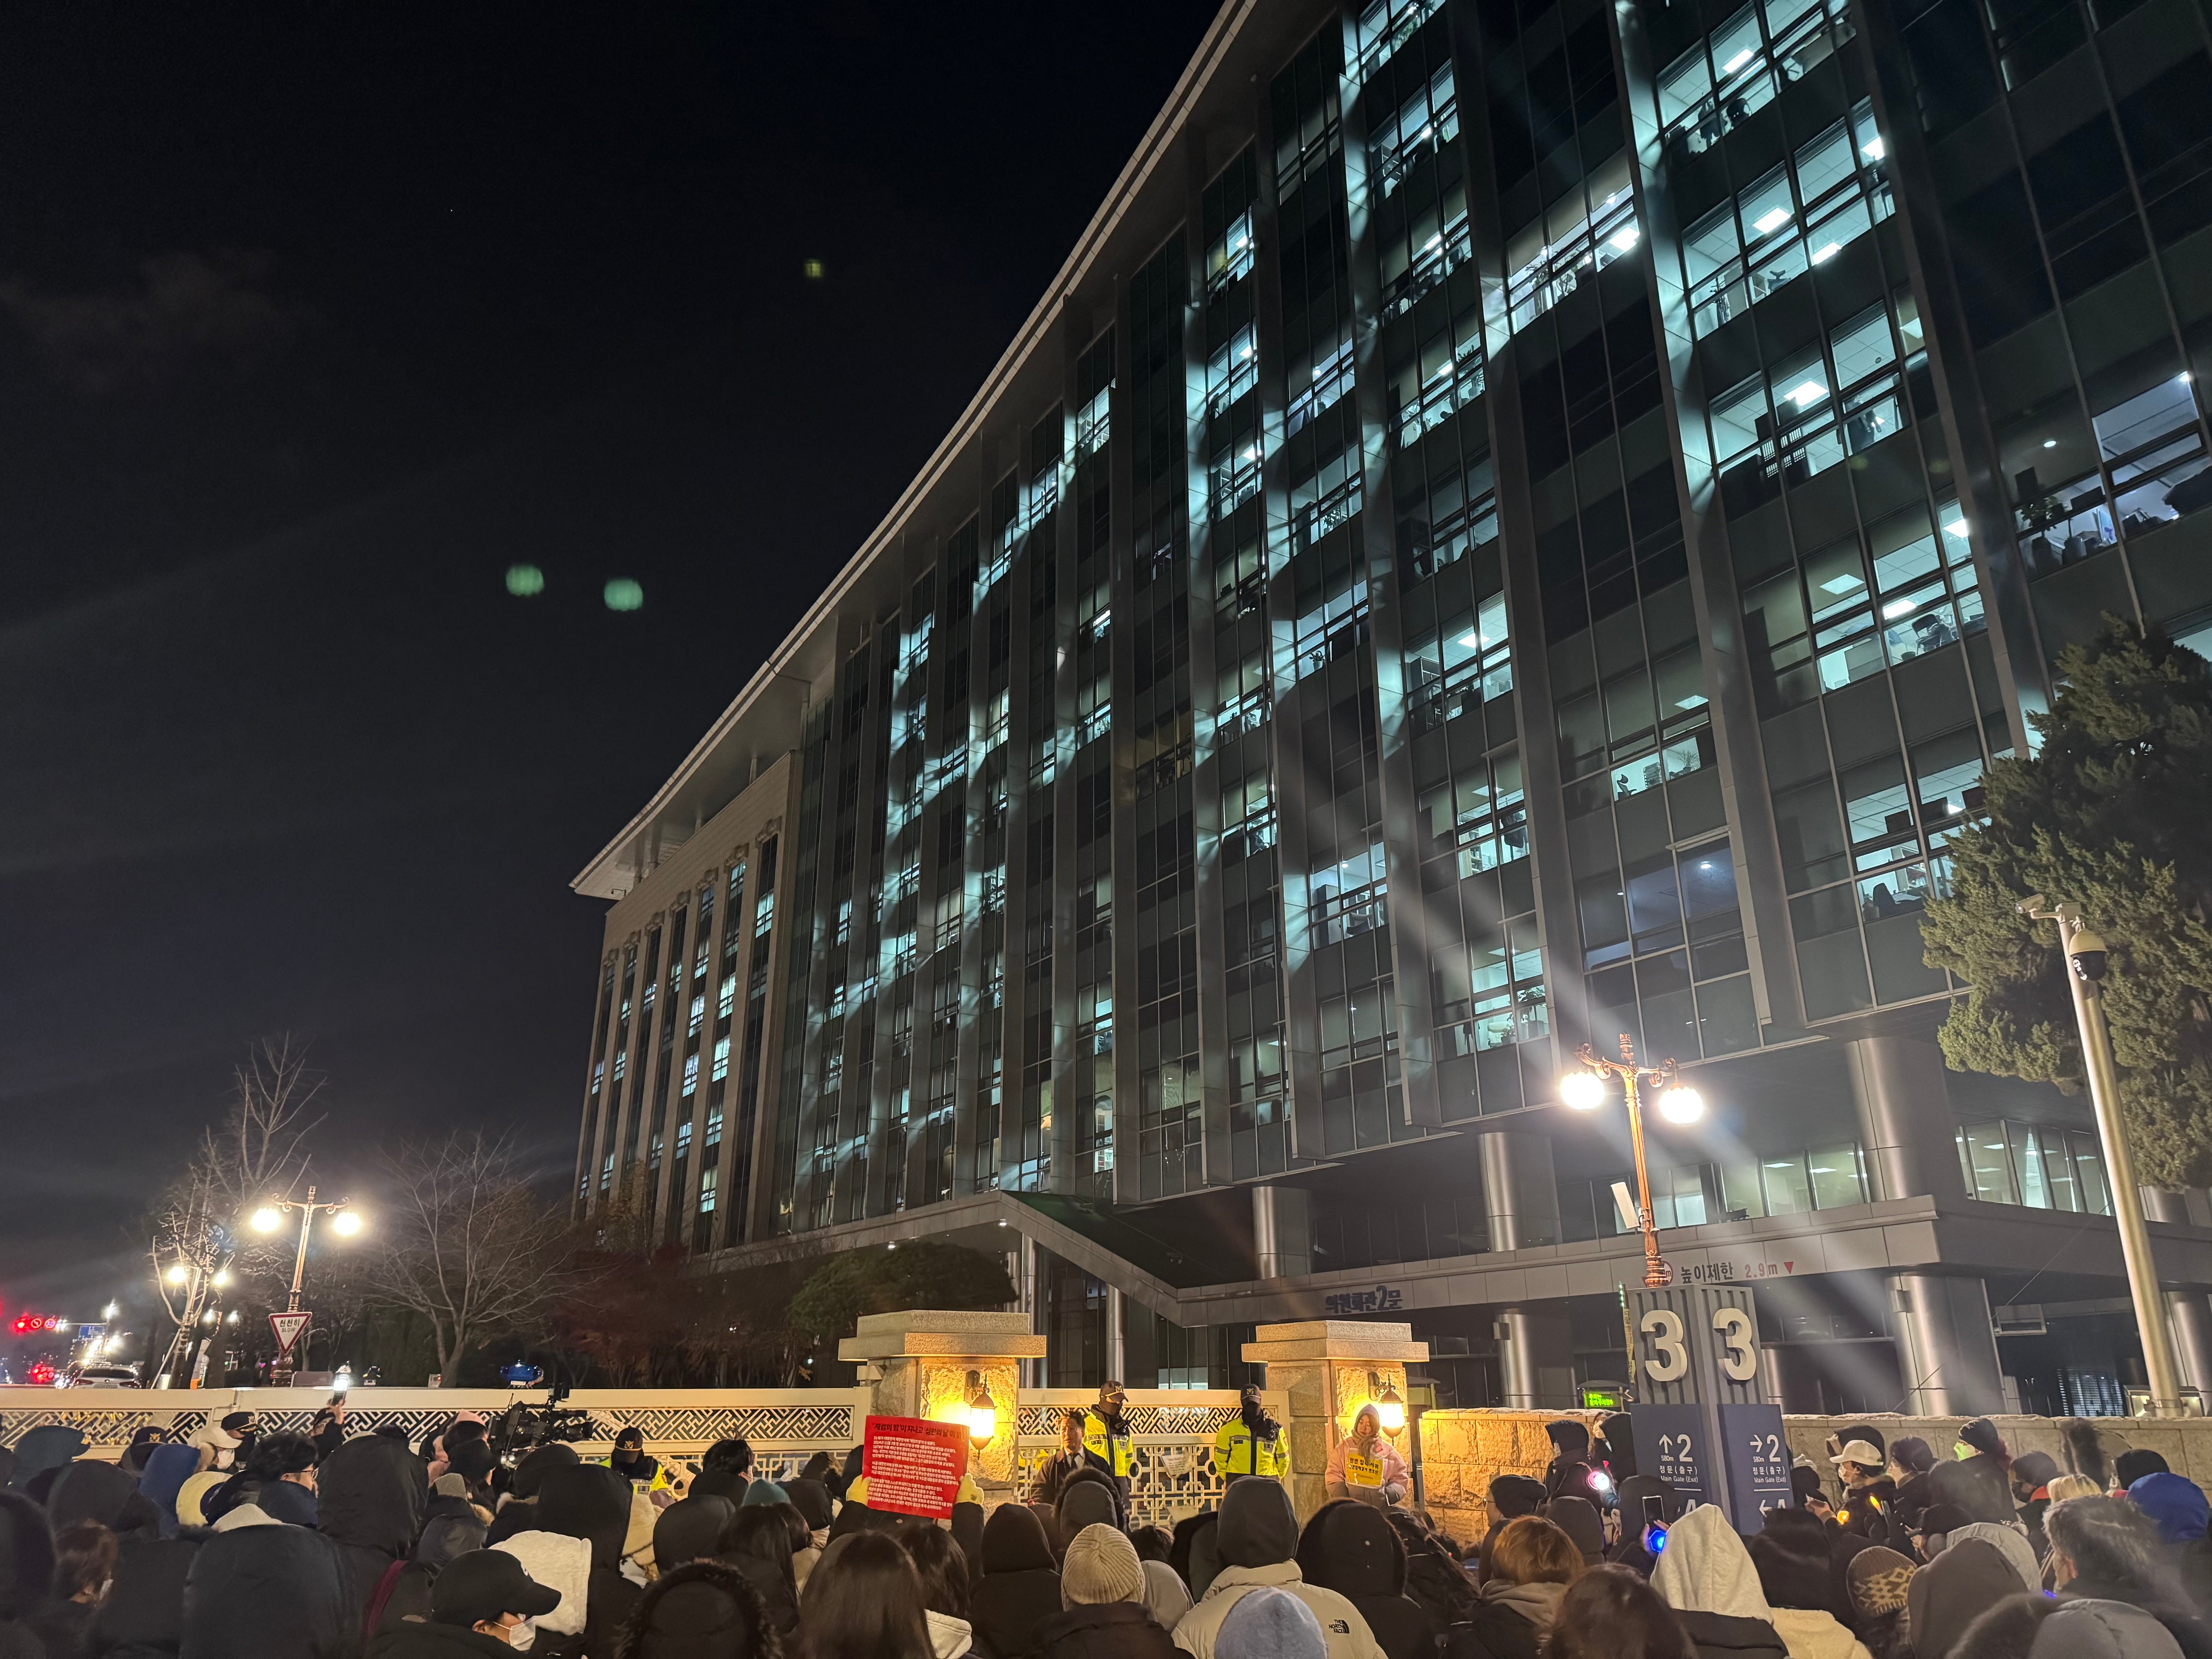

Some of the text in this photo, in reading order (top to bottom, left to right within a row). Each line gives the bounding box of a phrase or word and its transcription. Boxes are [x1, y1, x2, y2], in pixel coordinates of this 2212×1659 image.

[1681, 1262, 1778, 1284] 높이제한 2.9m
[280, 1319, 300, 1327] 천천히
[1641, 1310, 1687, 1381] 3
[1713, 1308, 1756, 1380] 3
[1677, 1434, 1693, 1462] 2
[1767, 1434, 1781, 1462] 2
